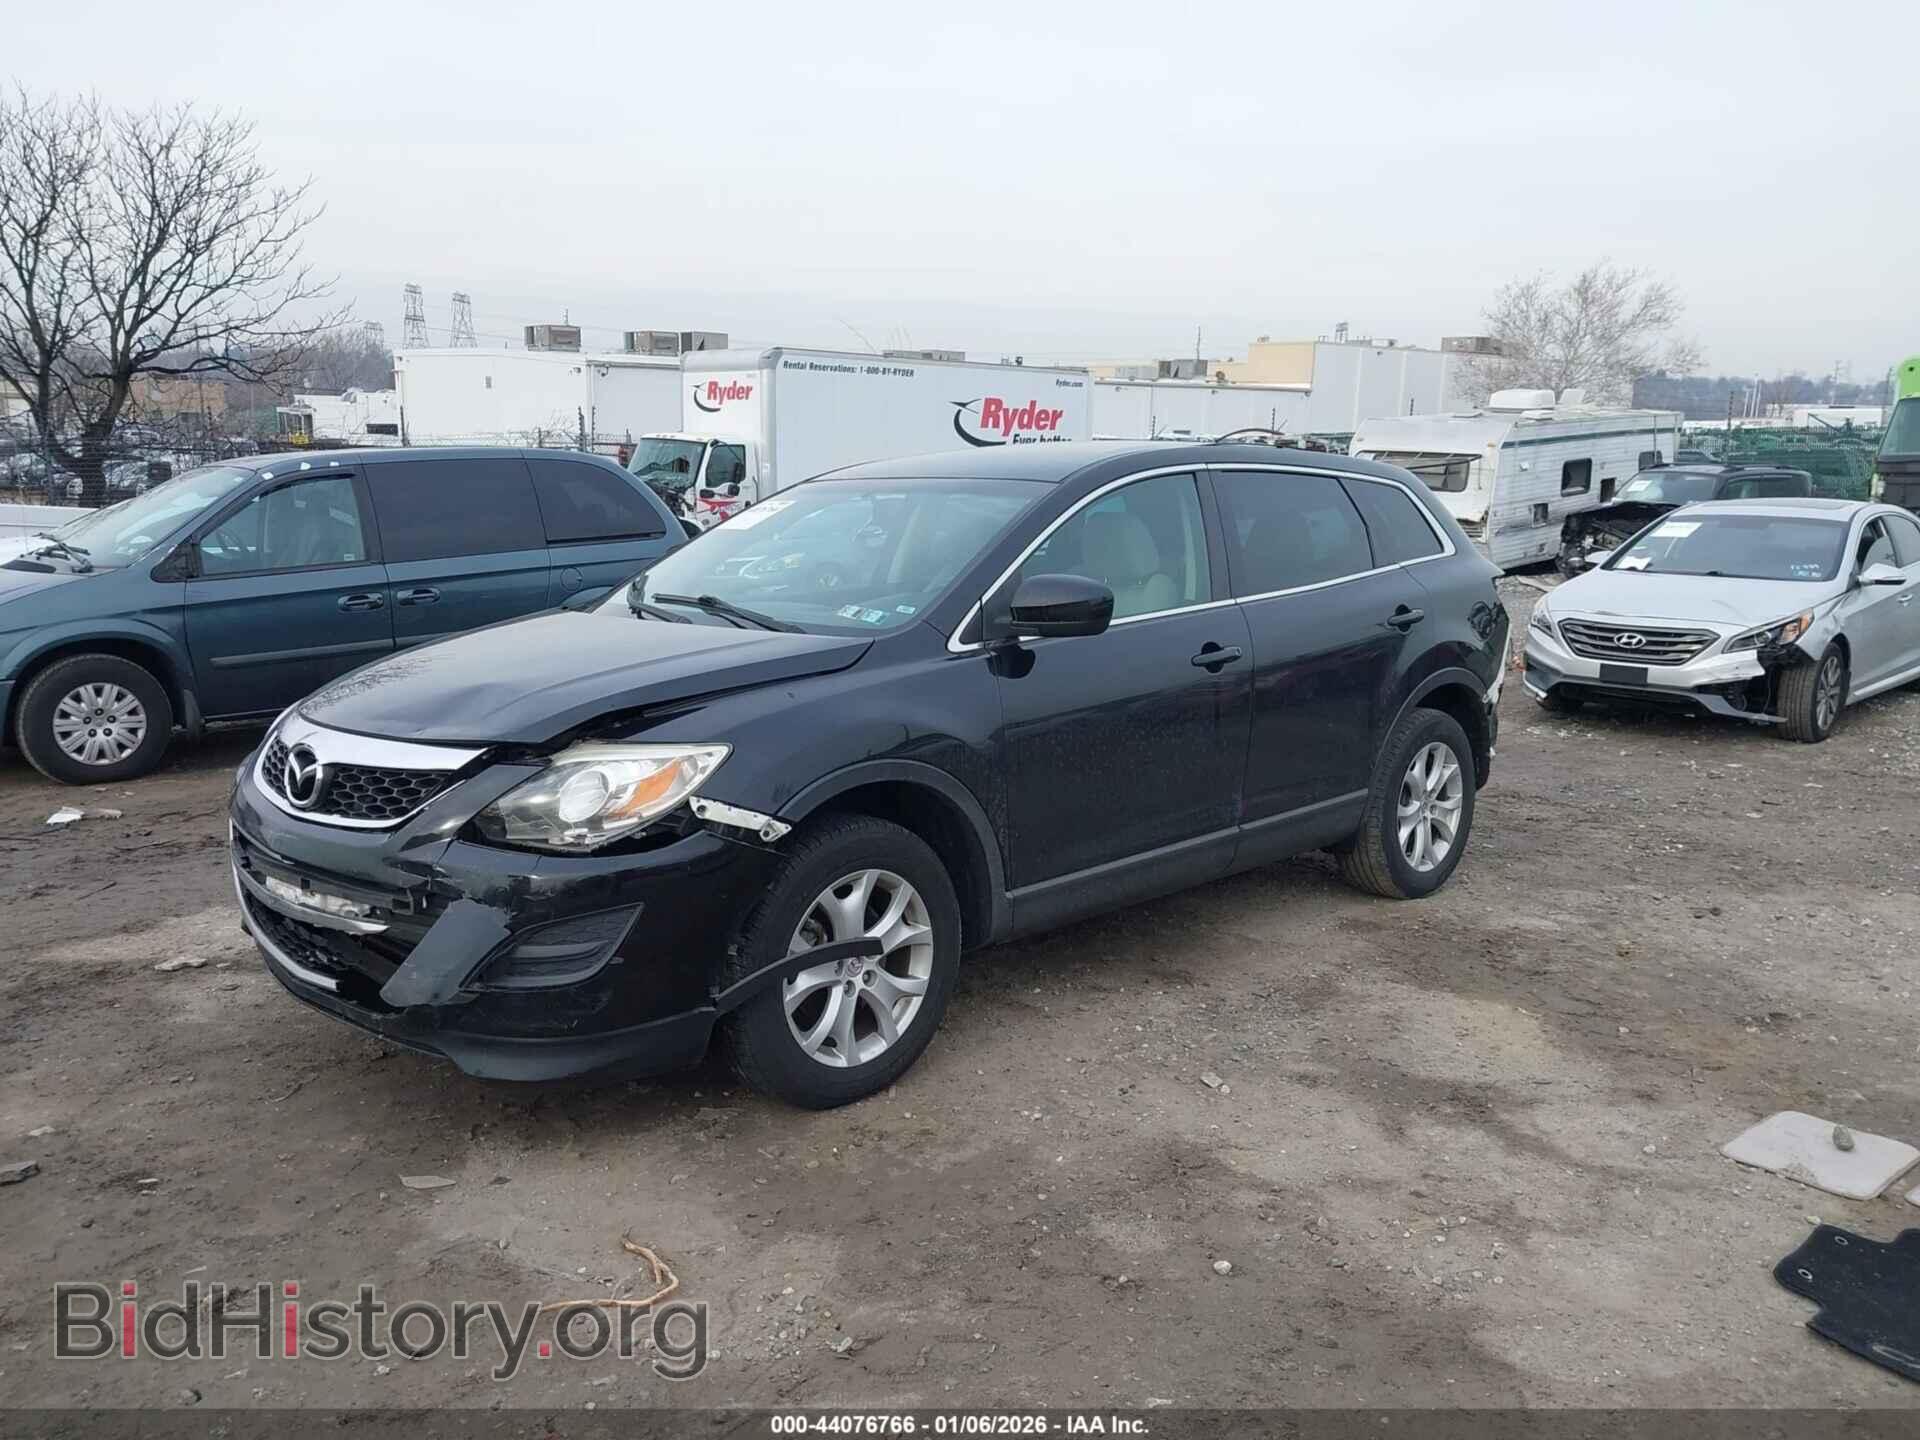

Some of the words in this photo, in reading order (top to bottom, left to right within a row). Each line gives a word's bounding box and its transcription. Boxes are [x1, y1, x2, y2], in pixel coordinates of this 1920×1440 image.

[783, 360, 807, 370] Rental
[809, 362, 857, 374] Reservations:
[707, 380, 753, 405] Ryder
[980, 397, 1064, 437] Ryder
